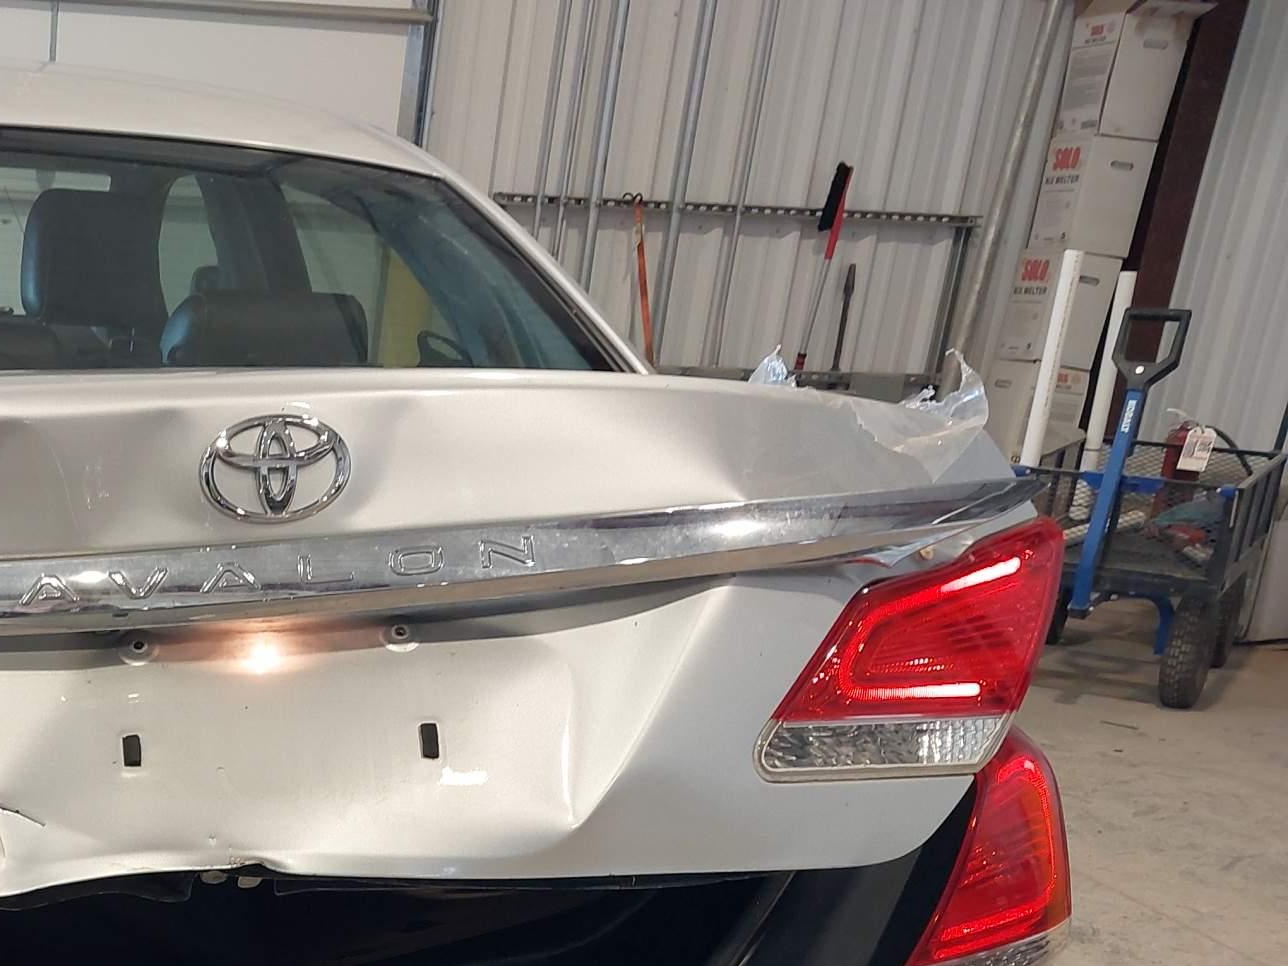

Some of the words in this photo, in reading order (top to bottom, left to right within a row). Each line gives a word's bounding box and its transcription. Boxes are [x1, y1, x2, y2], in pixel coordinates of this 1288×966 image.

[1053, 146, 1081, 171] SOLO
[1021, 258, 1050, 282] SOLO
[18, 534, 536, 606] AVALON
